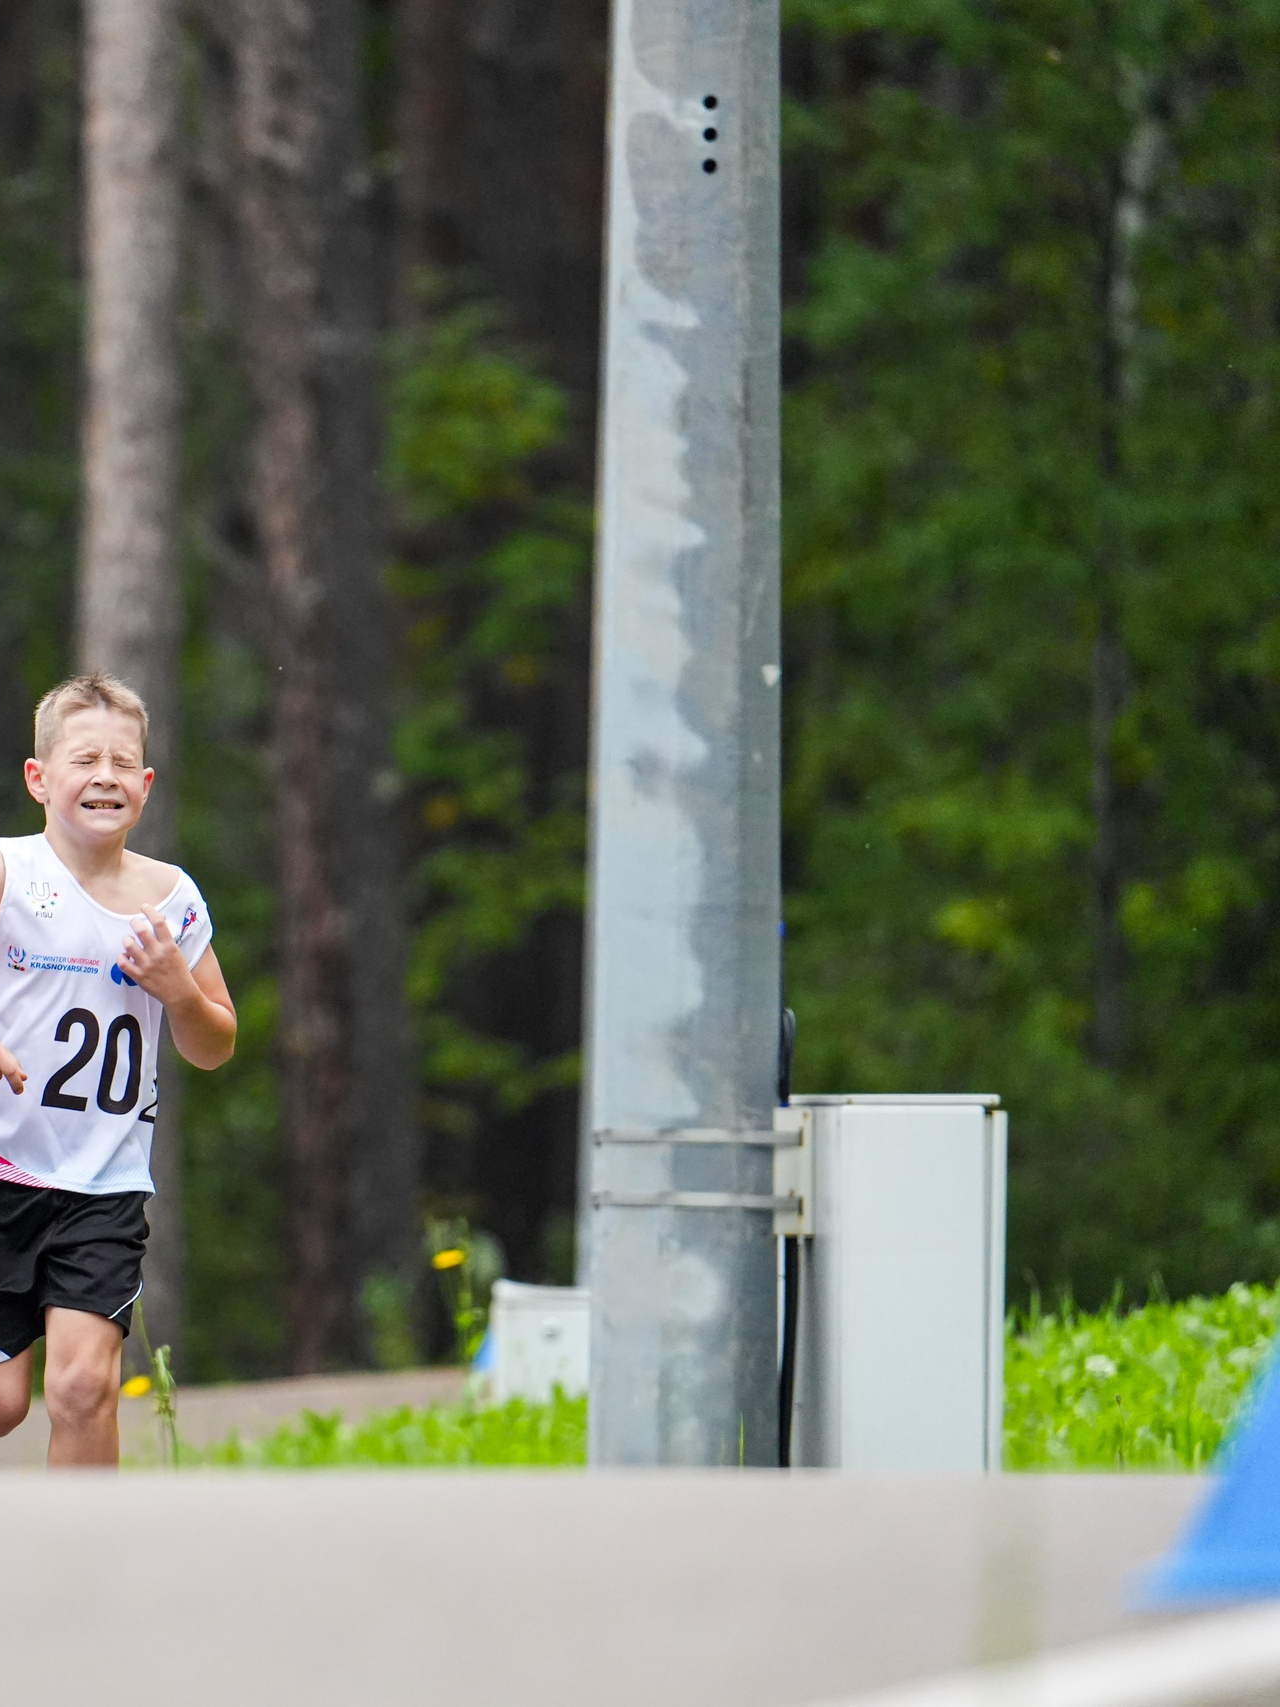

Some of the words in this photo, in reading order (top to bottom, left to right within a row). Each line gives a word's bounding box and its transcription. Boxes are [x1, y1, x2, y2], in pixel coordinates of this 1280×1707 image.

[35, 911, 53, 919] FISU
[43, 955, 67, 963] WINTER
[67, 957, 100, 967] UNIVERSIADE
[30, 961, 83, 973] KRASNOYARSK
[83, 965, 99, 975] 2019
[40, 1007, 143, 1116] 20
